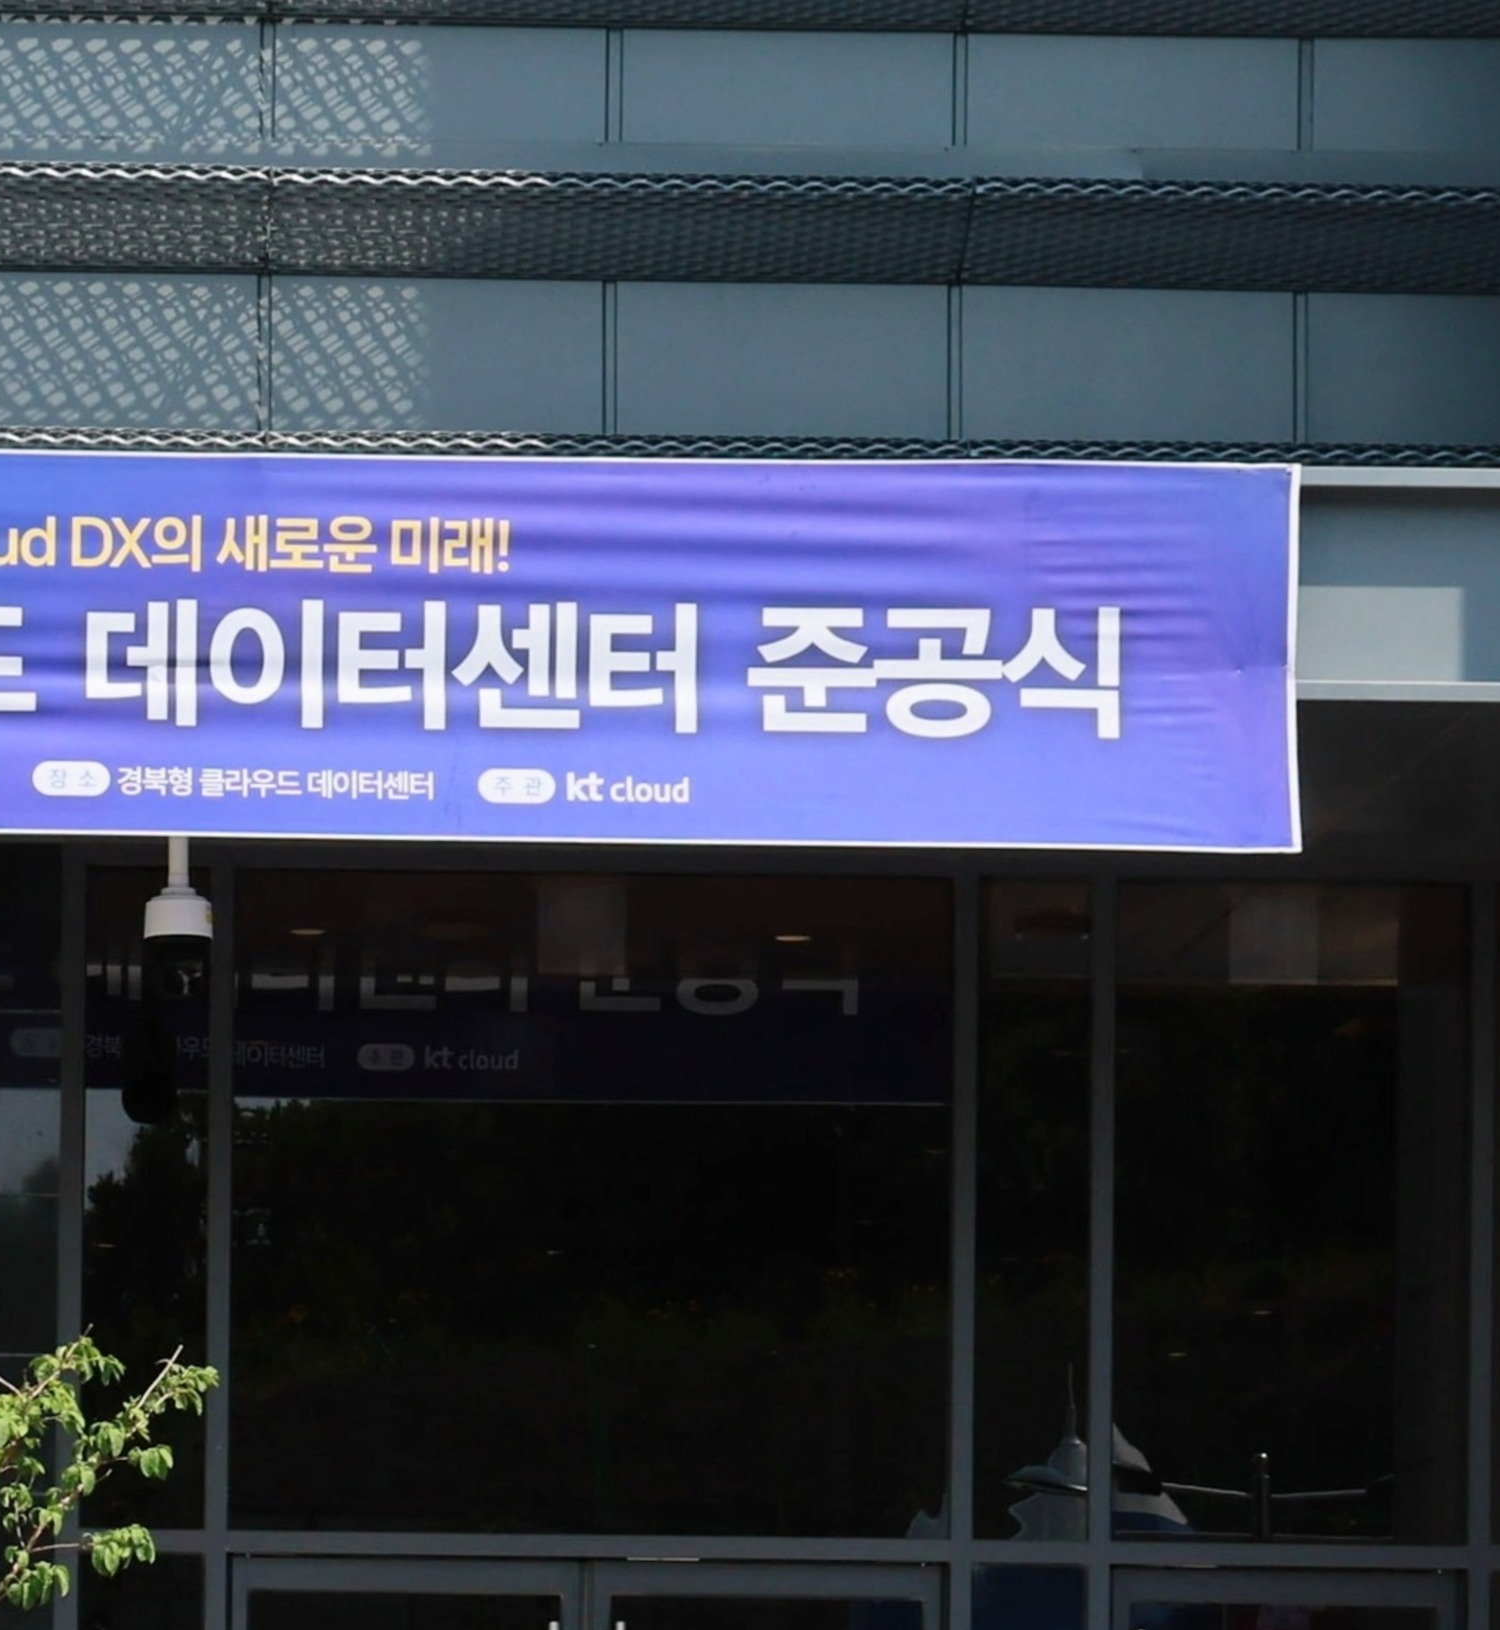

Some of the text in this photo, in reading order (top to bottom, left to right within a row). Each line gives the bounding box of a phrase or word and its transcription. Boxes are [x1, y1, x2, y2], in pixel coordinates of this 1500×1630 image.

[71, 515, 201, 572] DX의
[216, 515, 377, 573] 새로운
[390, 517, 509, 574] 미래!
[85, 599, 698, 733] 데이터센터
[747, 607, 1120, 739] 준공식
[118, 766, 192, 796] 경북형
[199, 768, 302, 797] 클라우드
[308, 770, 433, 800] 데이터센터
[567, 772, 604, 801] kt
[610, 776, 689, 803] cloud
